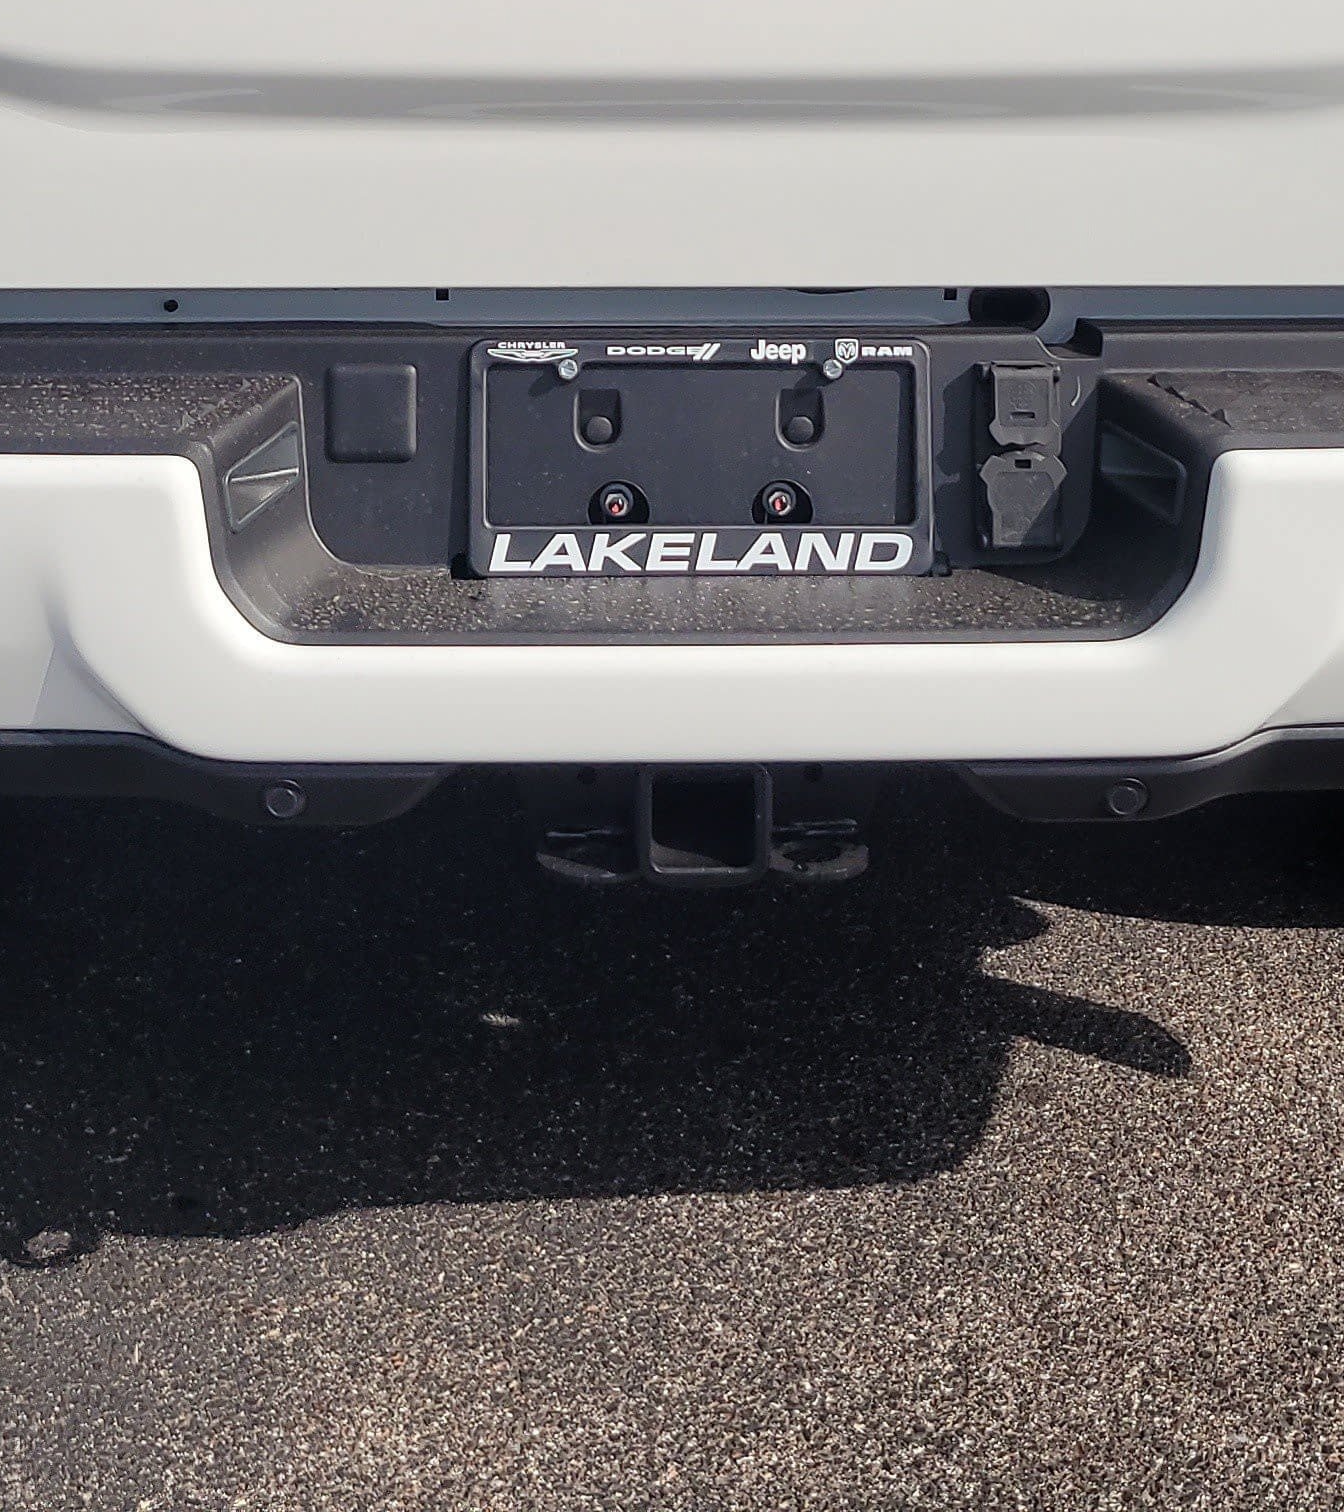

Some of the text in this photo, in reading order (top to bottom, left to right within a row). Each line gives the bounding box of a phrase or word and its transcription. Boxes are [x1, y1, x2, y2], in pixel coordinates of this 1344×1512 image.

[497, 340, 567, 350] CHRYSLER
[605, 345, 704, 357] DODGE
[750, 338, 808, 365] Jeep
[860, 345, 914, 358] RAM
[488, 532, 914, 573] LAKELAND
